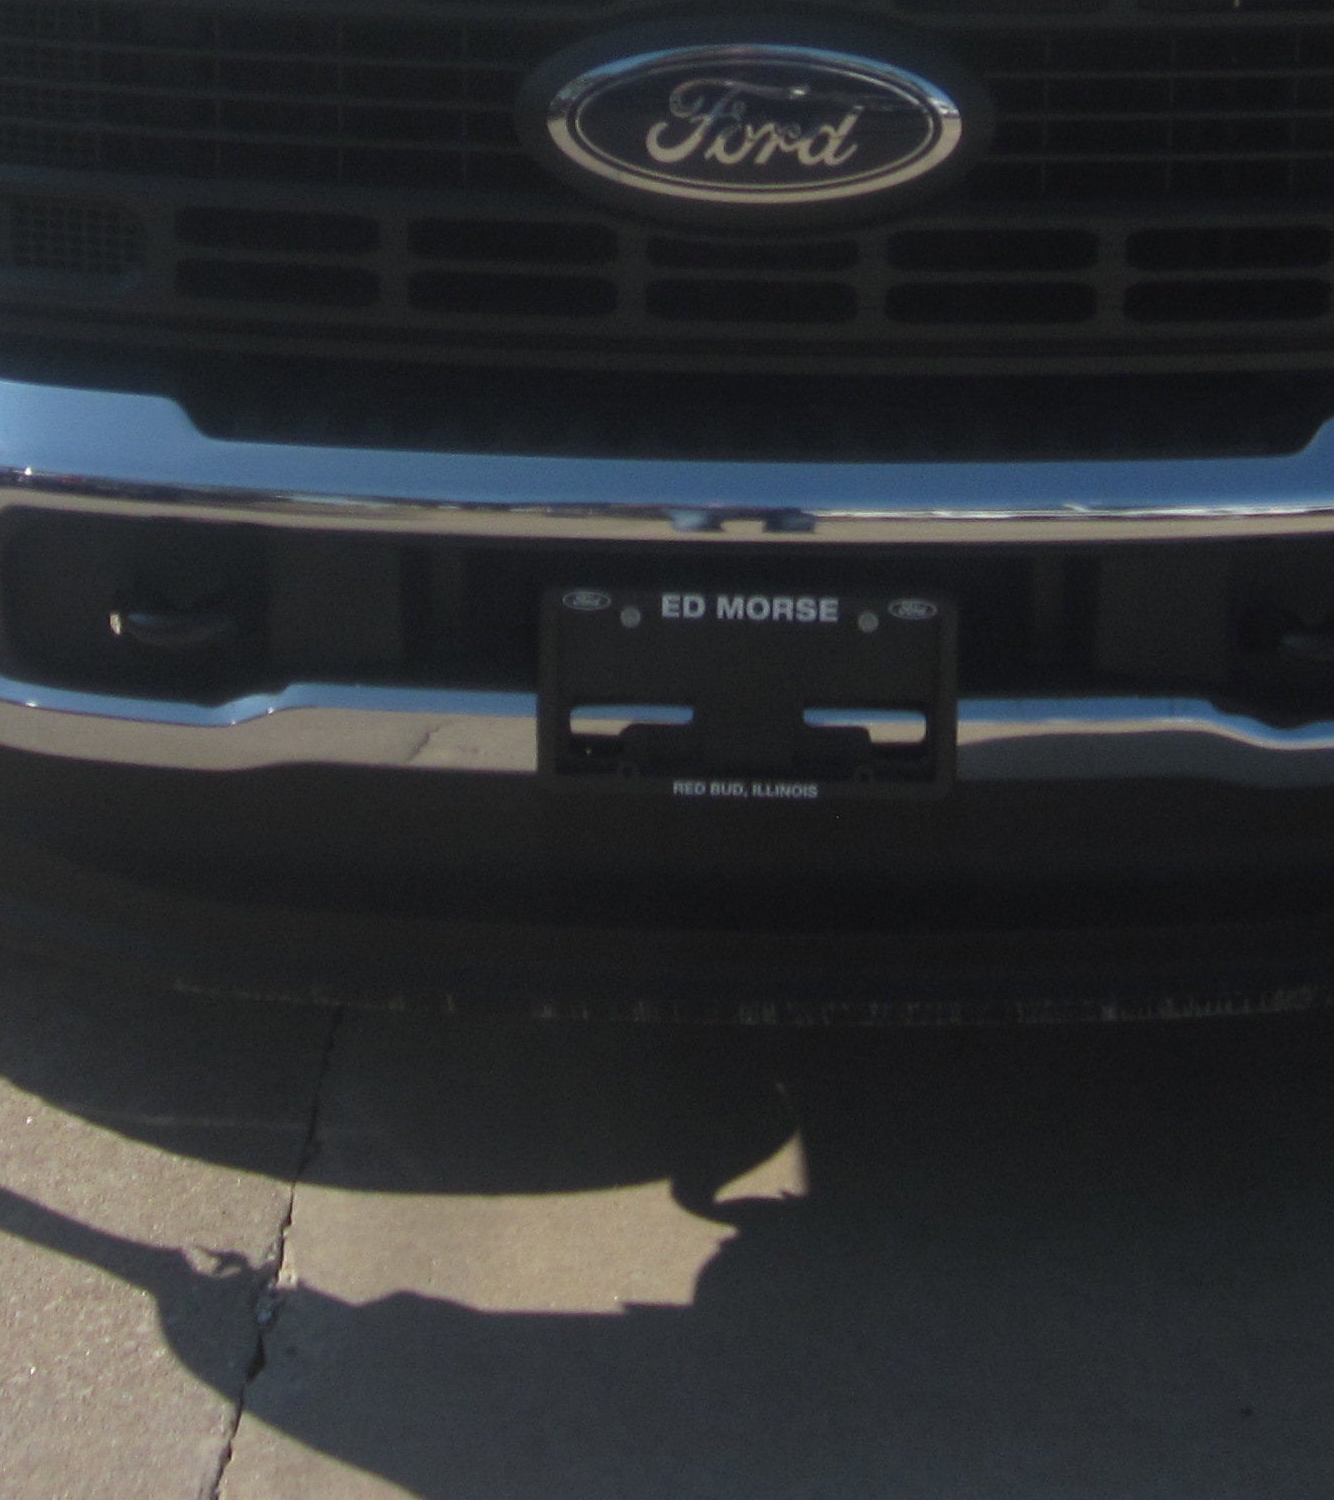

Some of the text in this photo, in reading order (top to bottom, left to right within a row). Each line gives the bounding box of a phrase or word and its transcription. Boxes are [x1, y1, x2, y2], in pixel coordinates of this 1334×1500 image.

[646, 77, 863, 165] Ford
[661, 593, 840, 624] ED MORSE
[673, 780, 819, 799] RED BUD, ILLINOIS
